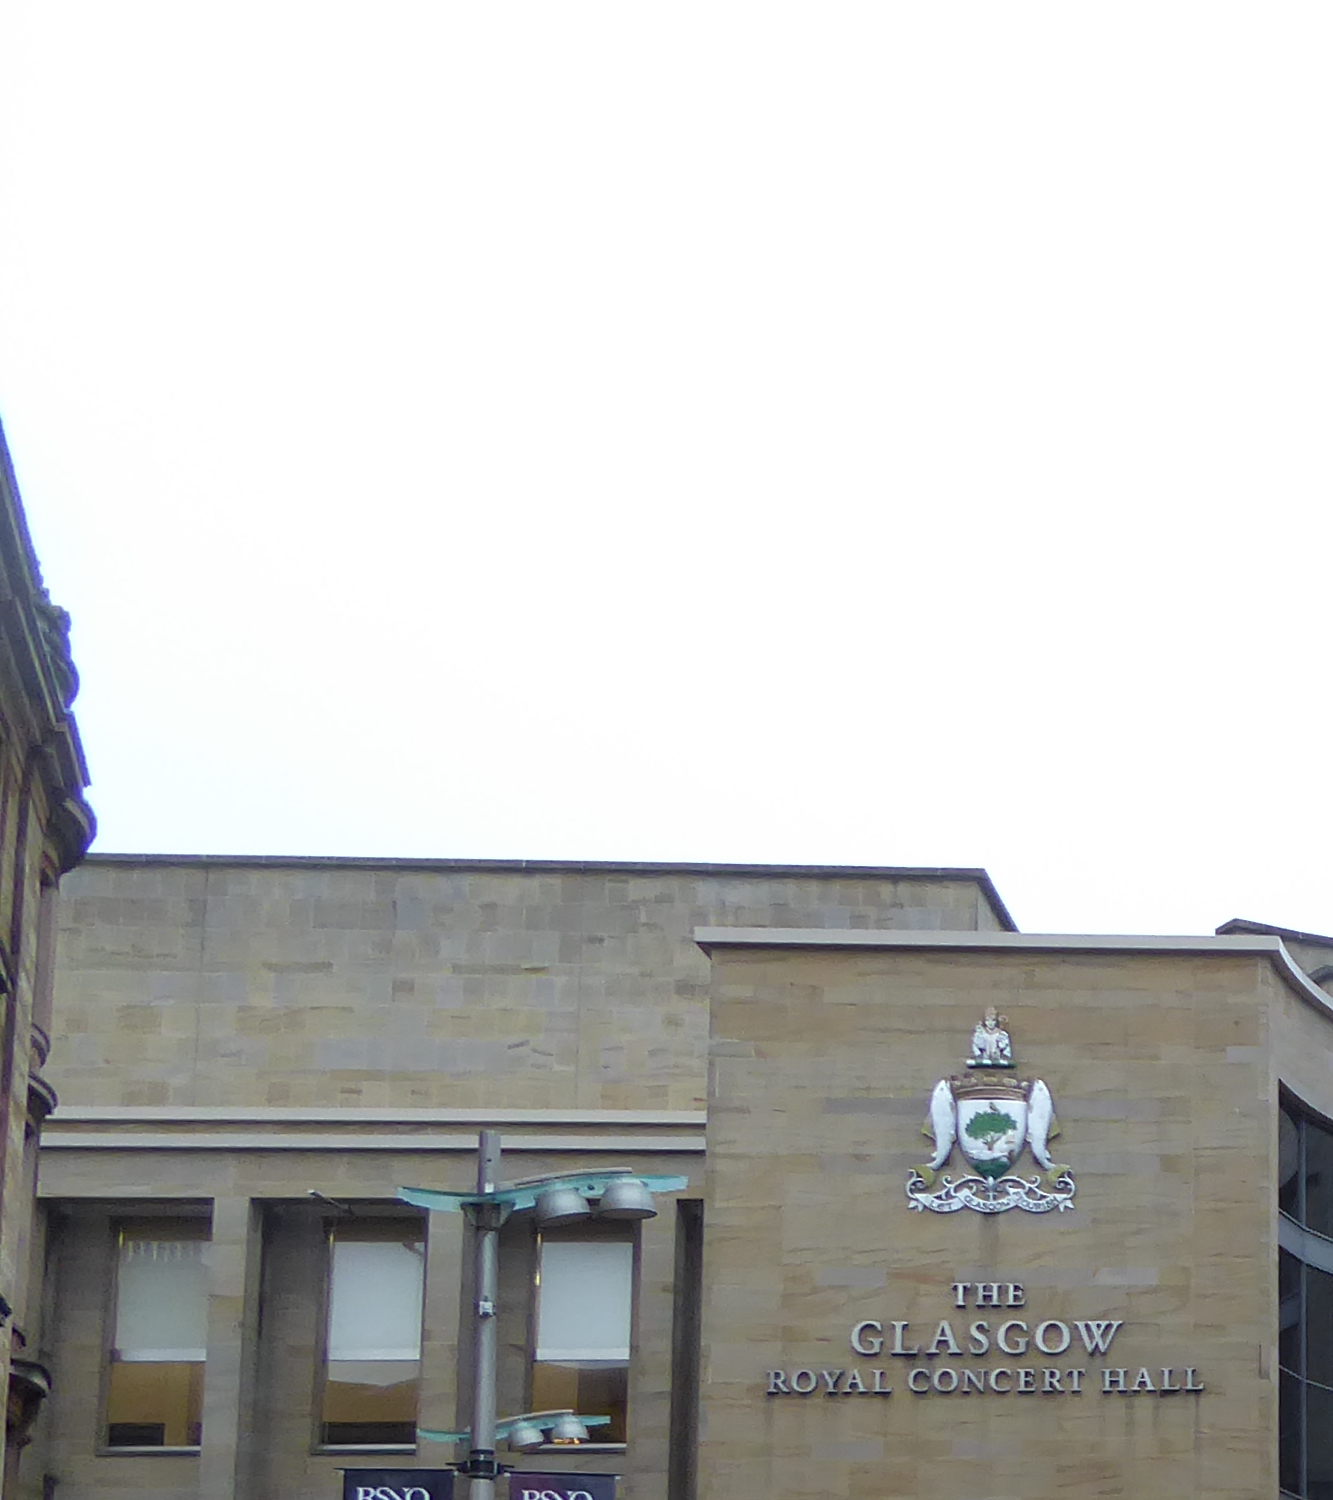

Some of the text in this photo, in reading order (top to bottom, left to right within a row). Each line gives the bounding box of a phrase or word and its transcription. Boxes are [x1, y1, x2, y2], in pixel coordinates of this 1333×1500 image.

[950, 1282, 1027, 1309] THE
[850, 1319, 1123, 1356] GLASGOW
[766, 1366, 1205, 1396] ROYAL CONCERT HALL
